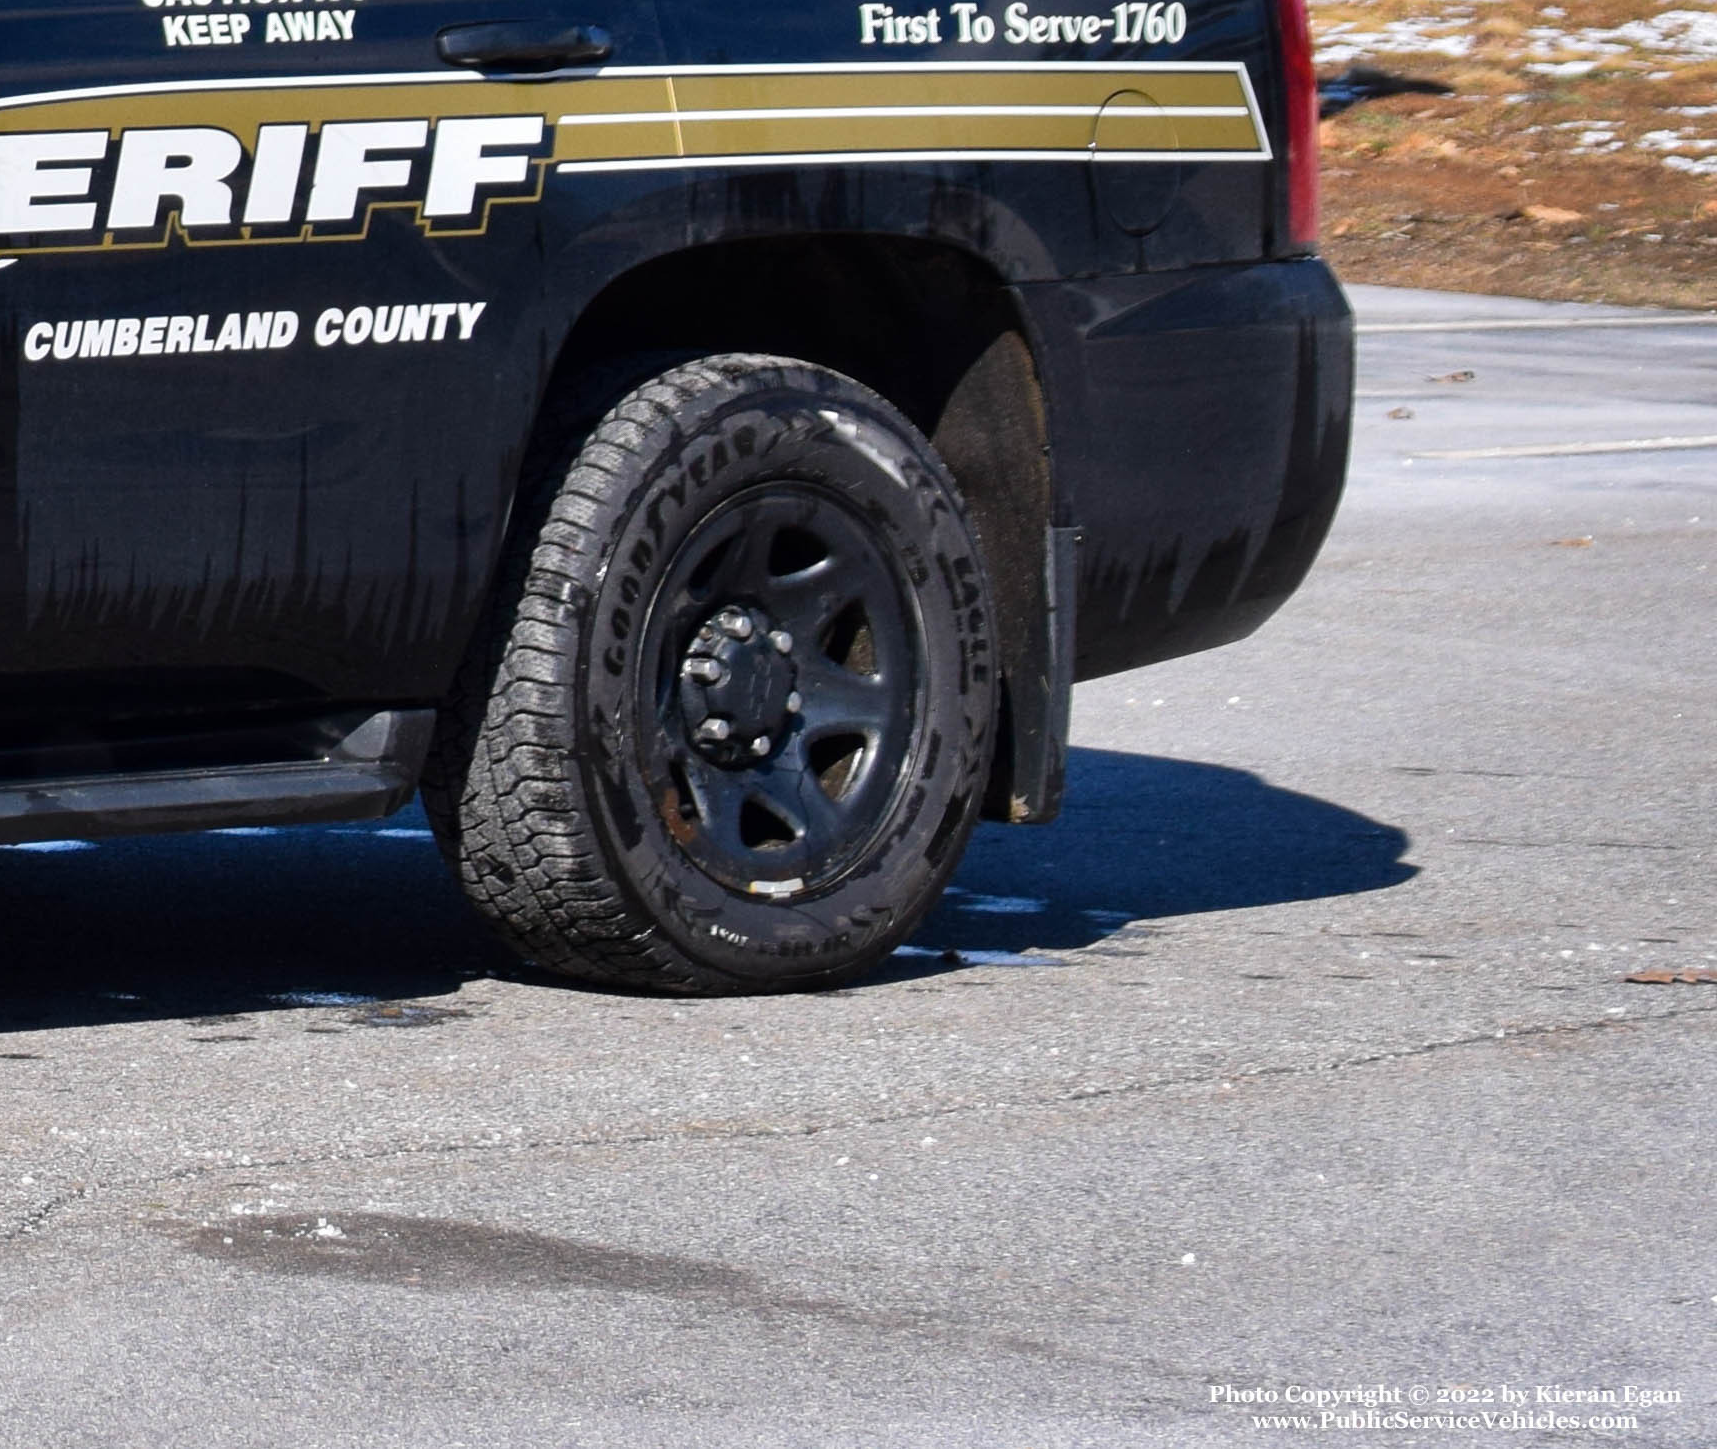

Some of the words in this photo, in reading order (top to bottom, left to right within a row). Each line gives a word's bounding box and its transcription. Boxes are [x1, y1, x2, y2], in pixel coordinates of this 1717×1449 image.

[162, 13, 251, 47] KEEP
[265, 9, 356, 43] AWAY
[858, 3, 942, 44] First
[950, 2, 996, 44] To
[1004, 2, 1187, 44] Serve-1760
[23, 309, 300, 362] CUMBERLAND
[313, 301, 487, 348] COUNTY
